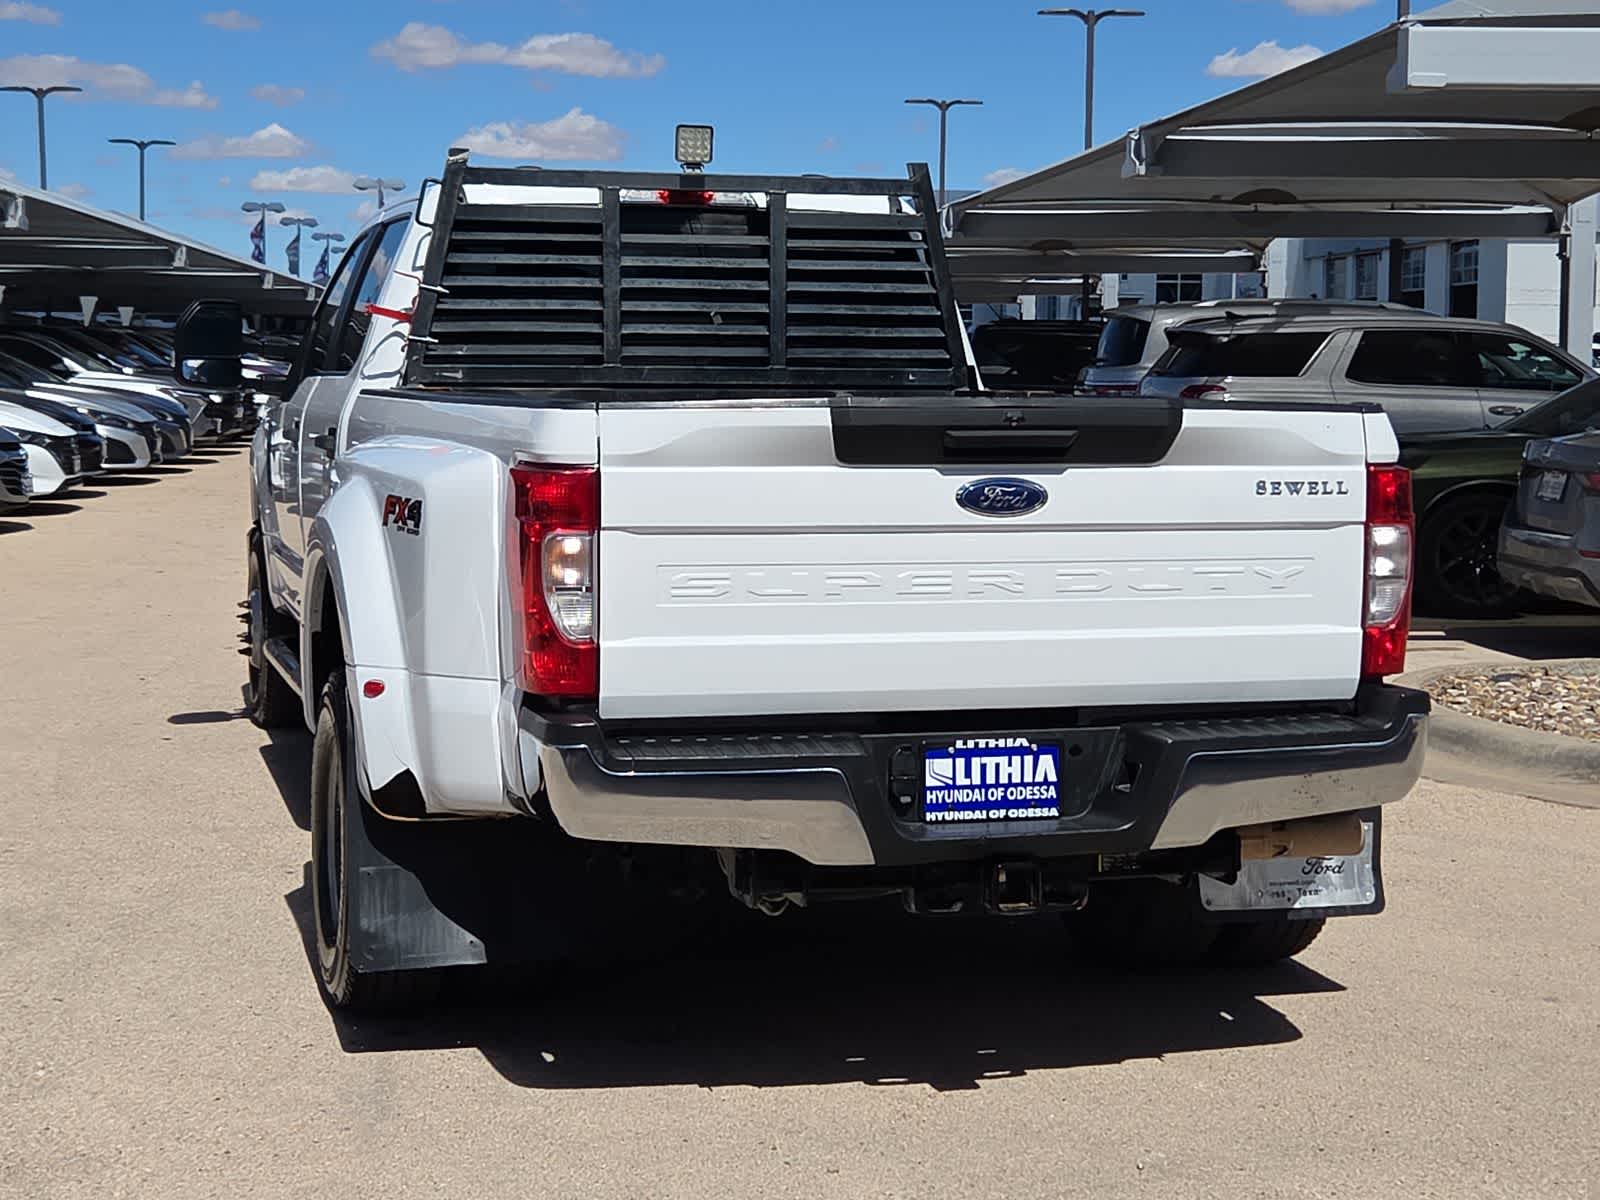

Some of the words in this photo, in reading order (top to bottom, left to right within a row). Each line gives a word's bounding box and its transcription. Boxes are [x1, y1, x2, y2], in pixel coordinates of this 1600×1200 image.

[980, 485, 1028, 508] Ford
[1255, 479, 1349, 496] SEWELL
[382, 494, 423, 529] FX4
[670, 570, 1026, 599] SUPER
[1055, 565, 1305, 593] DUTY
[955, 737, 1030, 749] LITHIA
[955, 754, 1058, 786] LITHIA
[926, 787, 986, 804] HYUNDAI
[987, 787, 1005, 801] OF
[1006, 785, 1057, 800] ODESSA
[925, 808, 987, 822] HYUNDAI
[988, 808, 1007, 819] OF
[1007, 807, 1059, 818] ODESSA
[1302, 856, 1345, 875] Ford
